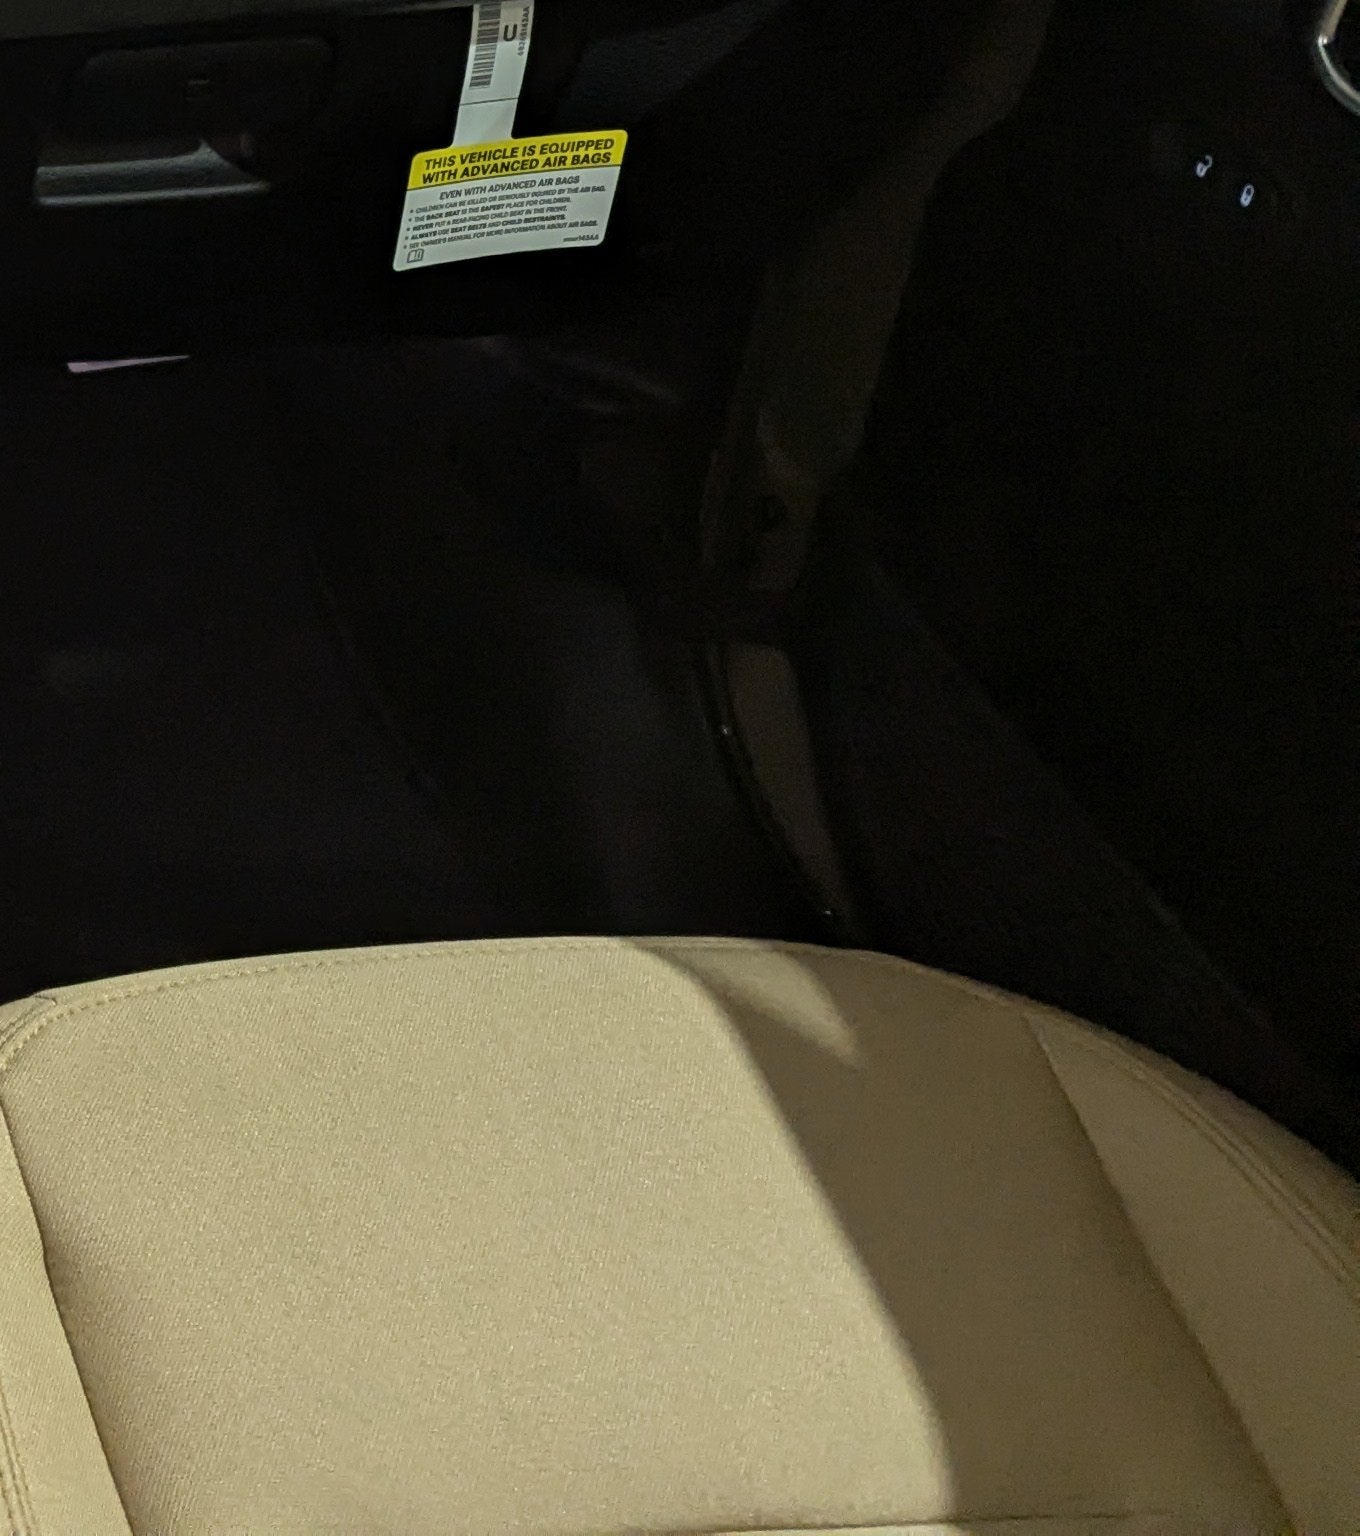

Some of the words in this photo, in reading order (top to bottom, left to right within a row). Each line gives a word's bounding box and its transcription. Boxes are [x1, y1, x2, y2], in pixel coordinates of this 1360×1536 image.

[503, 24, 517, 42] U
[422, 170, 457, 185] WITH
[460, 158, 540, 179] ADVANCED
[542, 155, 568, 168] AIR
[571, 151, 612, 166] BAGS
[424, 155, 456, 171] THIS
[460, 148, 519, 165] VEHICLE
[522, 145, 536, 157] IS
[540, 138, 615, 155] EQUIPPED
[439, 189, 462, 201] EVEN
[464, 185, 487, 197] WITH
[488, 178, 537, 194] ADVANCED
[538, 177, 554, 188] AIR
[555, 175, 580, 186] BAGS
